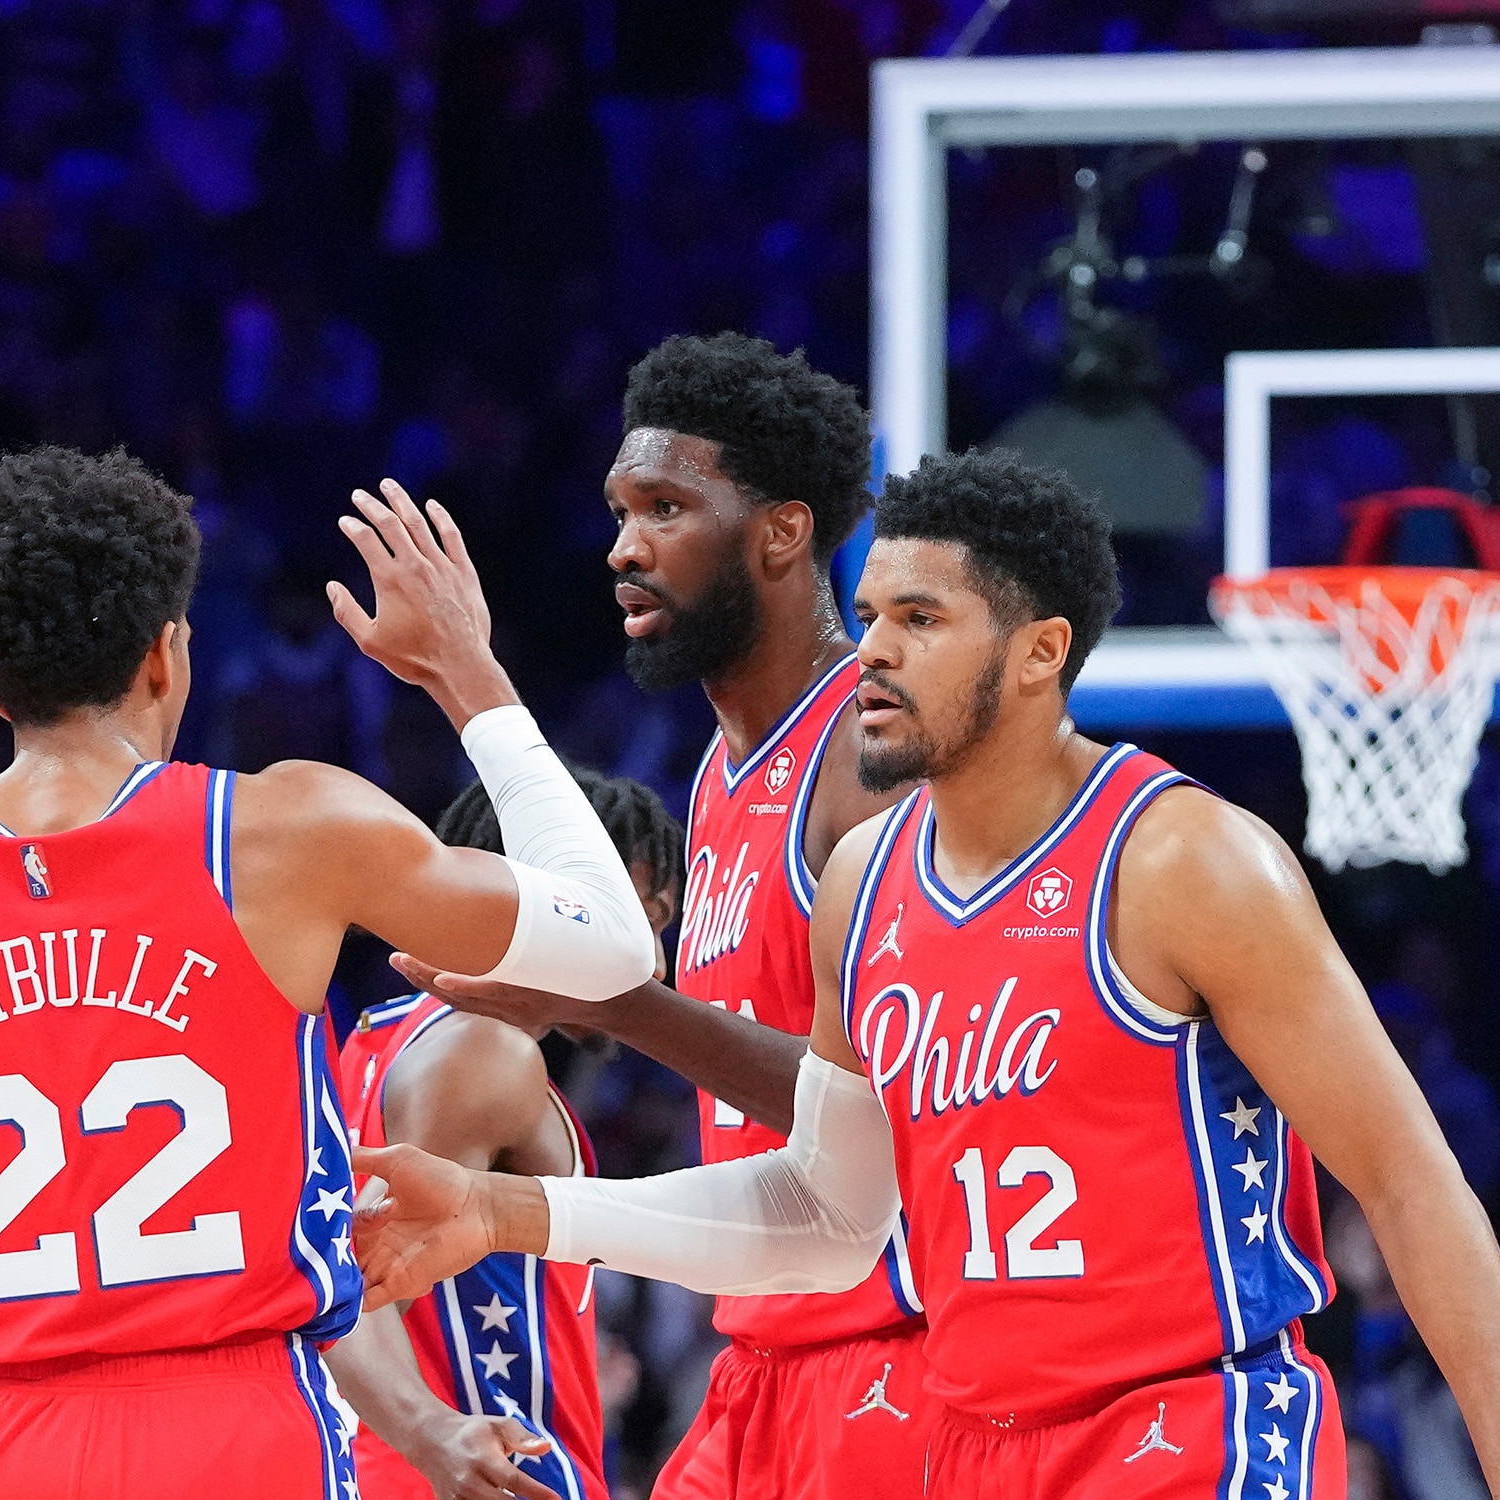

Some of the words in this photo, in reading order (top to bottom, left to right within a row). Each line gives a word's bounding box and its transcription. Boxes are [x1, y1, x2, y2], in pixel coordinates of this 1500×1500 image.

[748, 803, 789, 817] crypto.com
[677, 841, 760, 982] Phila
[1003, 925, 1080, 940] crypto.com
[859, 976, 1061, 1128] Phila
[952, 1145, 1085, 1281] 12
